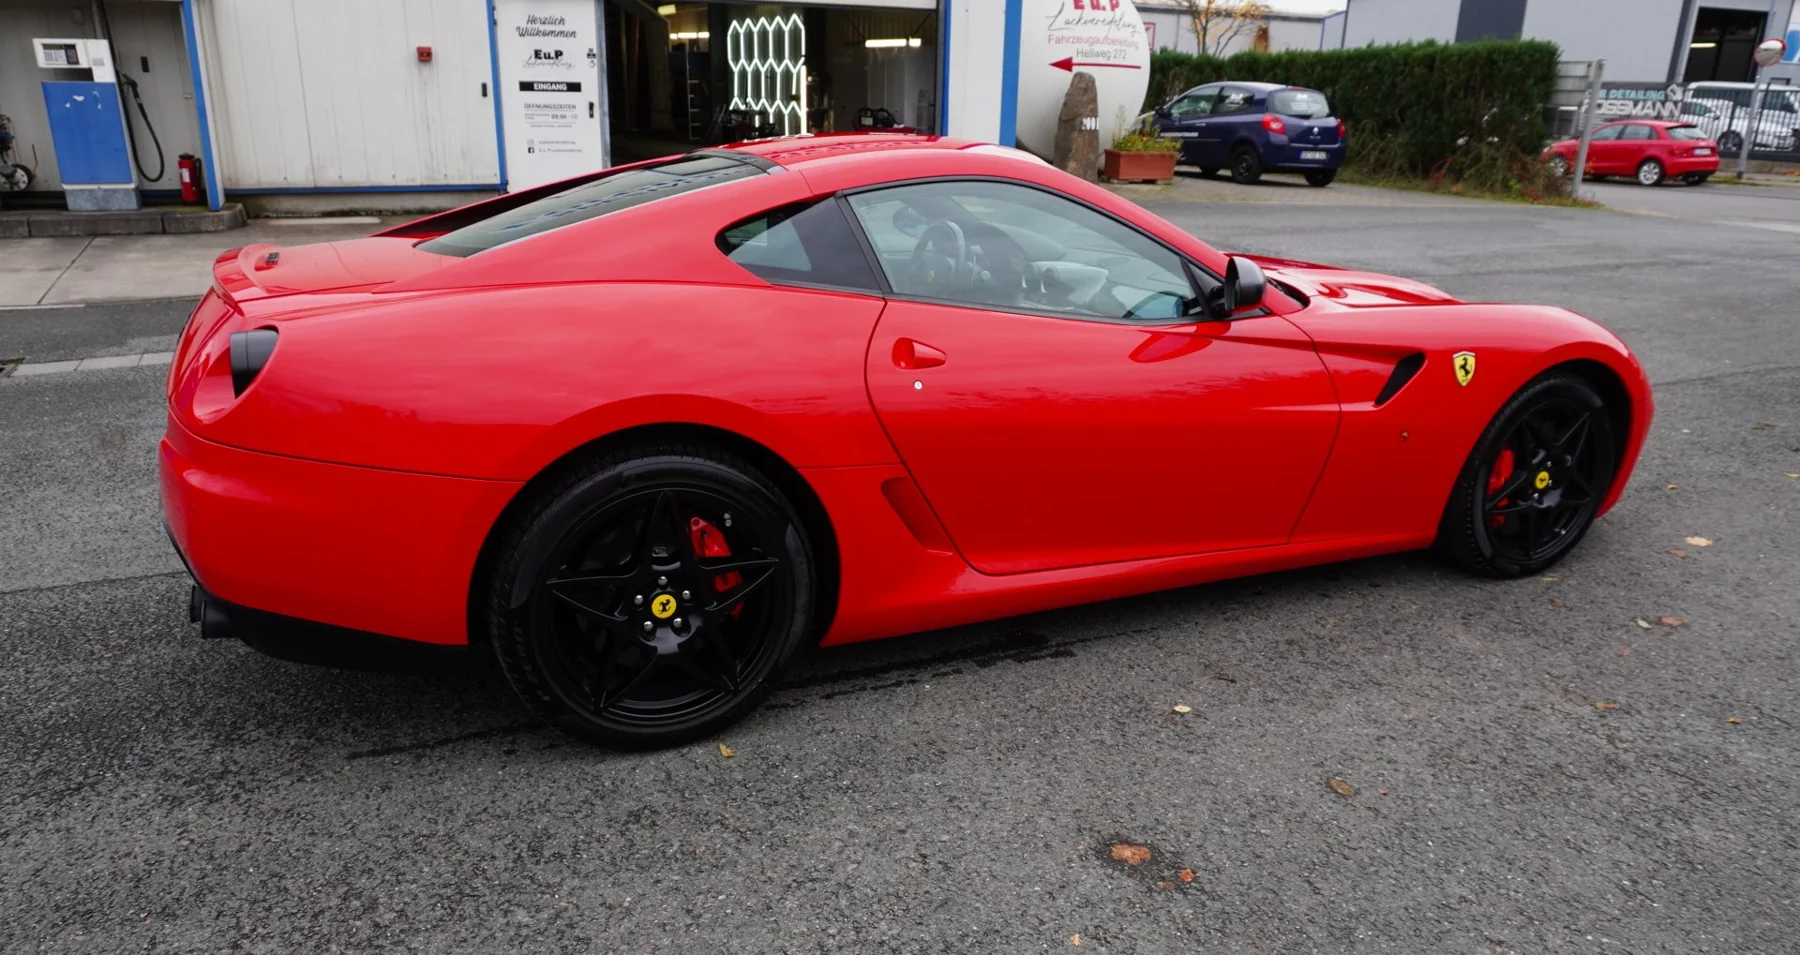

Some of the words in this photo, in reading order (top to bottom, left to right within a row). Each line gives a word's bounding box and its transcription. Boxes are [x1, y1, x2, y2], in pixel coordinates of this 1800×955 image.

[526, 14, 566, 26] Herzlich
[515, 26, 577, 38] Willkommen
[1113, 49, 1127, 59] 272
[533, 82, 568, 91] EINGANG
[1608, 89, 1666, 100] DETAILING
